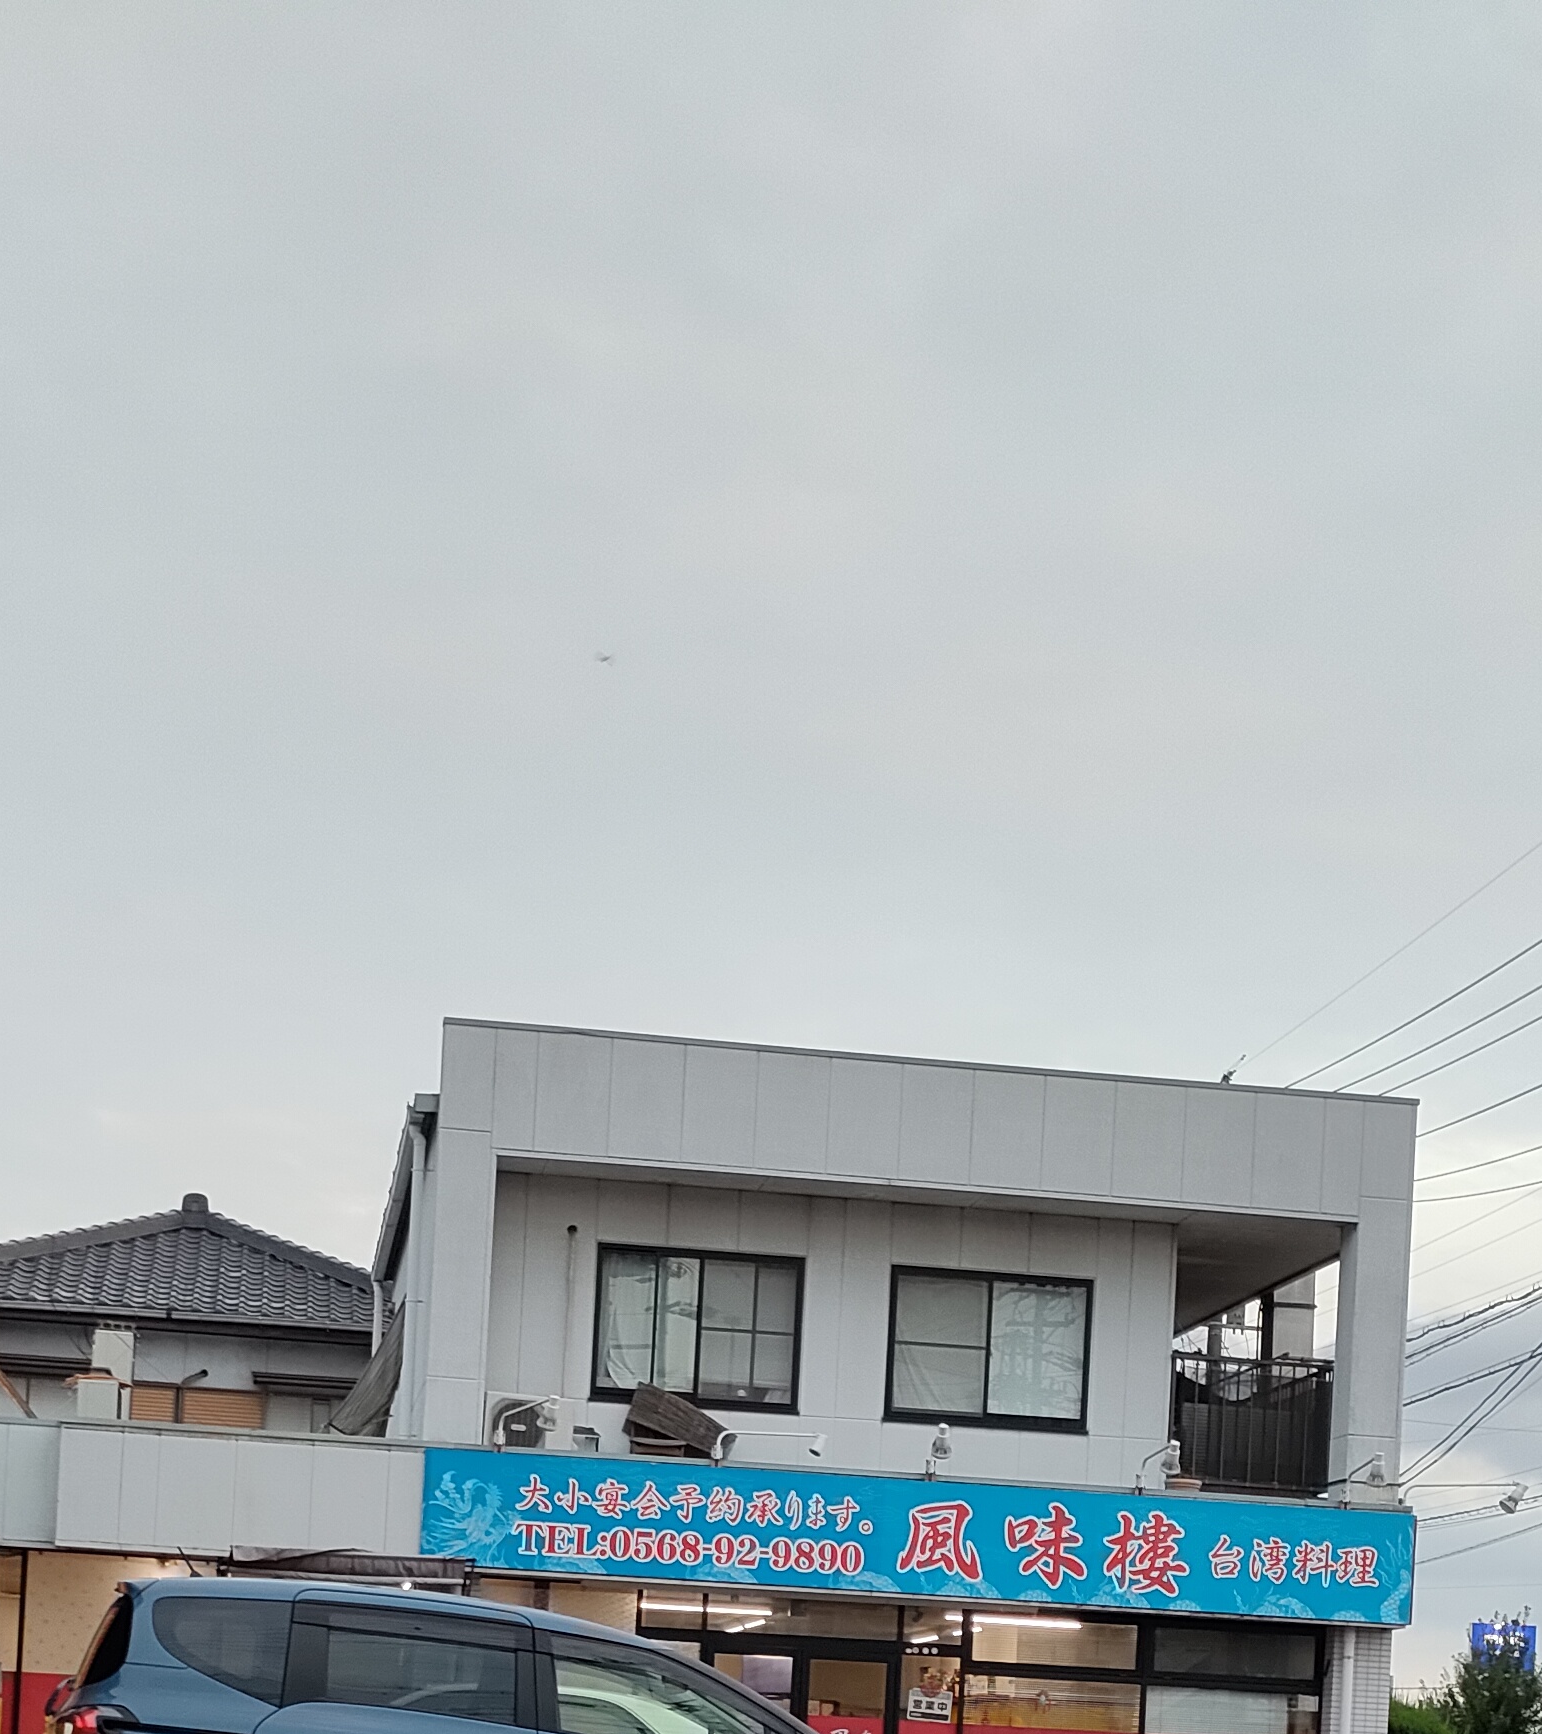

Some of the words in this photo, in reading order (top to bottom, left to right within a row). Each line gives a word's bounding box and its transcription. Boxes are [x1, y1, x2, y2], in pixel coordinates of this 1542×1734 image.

[515, 1474, 873, 1535] 大小宴会予約承ります。
[515, 1520, 864, 1576] TEL:0568-92-9890
[897, 1499, 1191, 1598] 風味樓
[1208, 1534, 1379, 1588] 台湾料理
